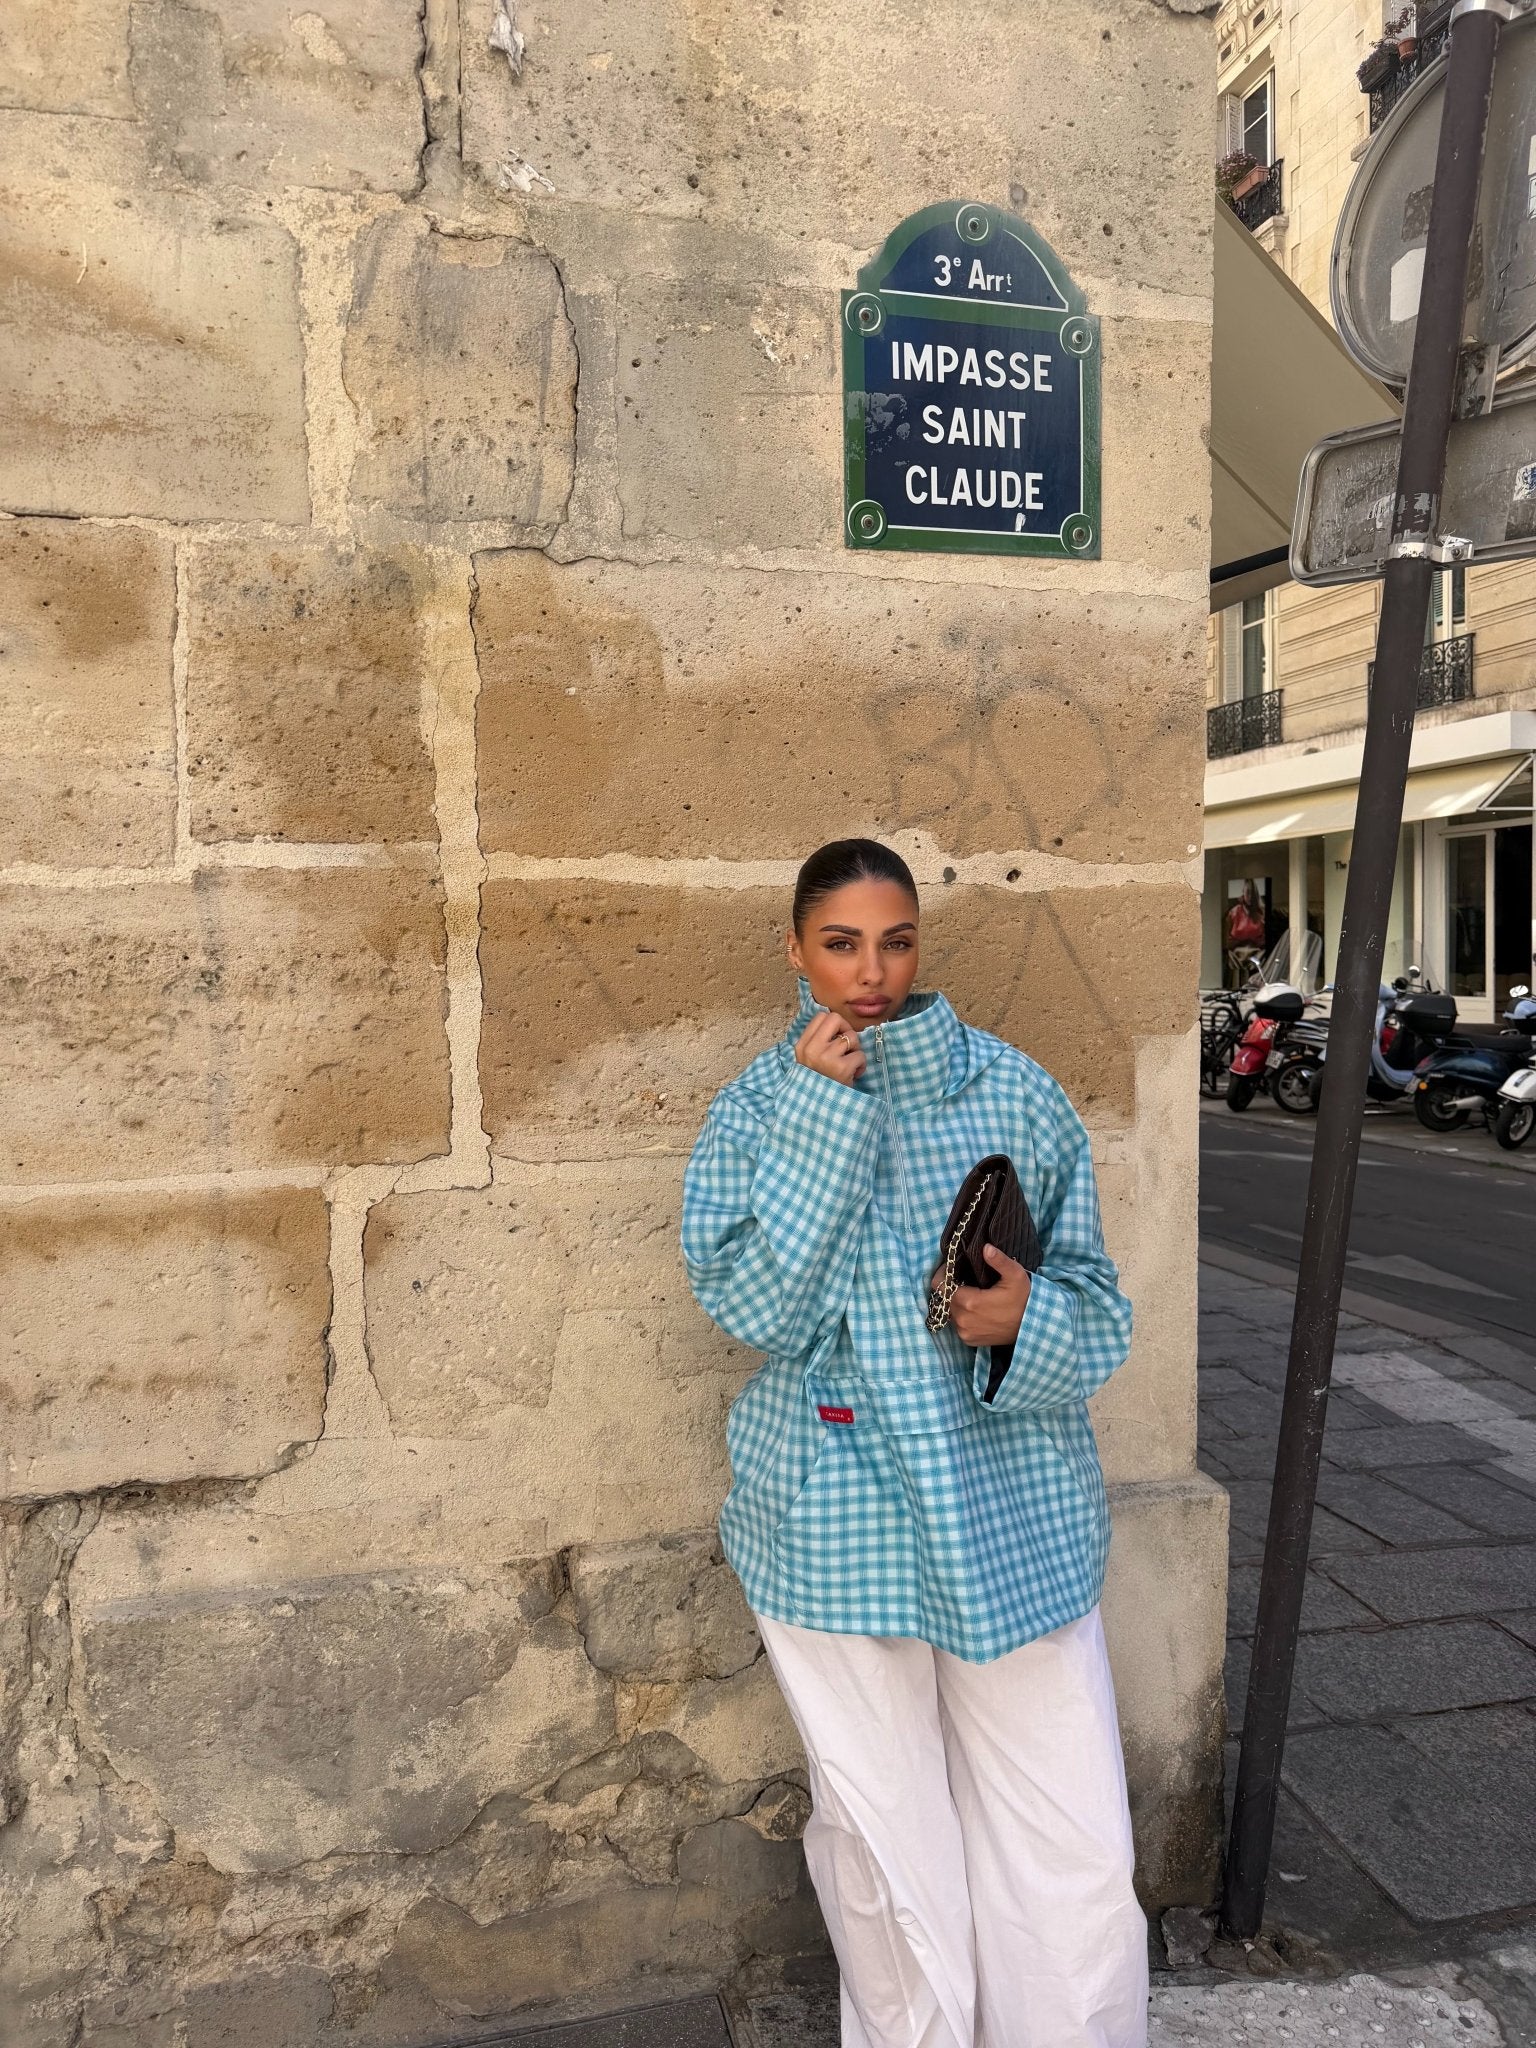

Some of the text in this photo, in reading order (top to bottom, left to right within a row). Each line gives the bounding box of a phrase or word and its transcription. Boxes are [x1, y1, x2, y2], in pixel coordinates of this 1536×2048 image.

[933, 254, 962, 287] 3e
[892, 341, 1053, 393] IMPASSE
[922, 404, 1026, 449] SAINT
[905, 464, 1044, 510] CLAUDE
